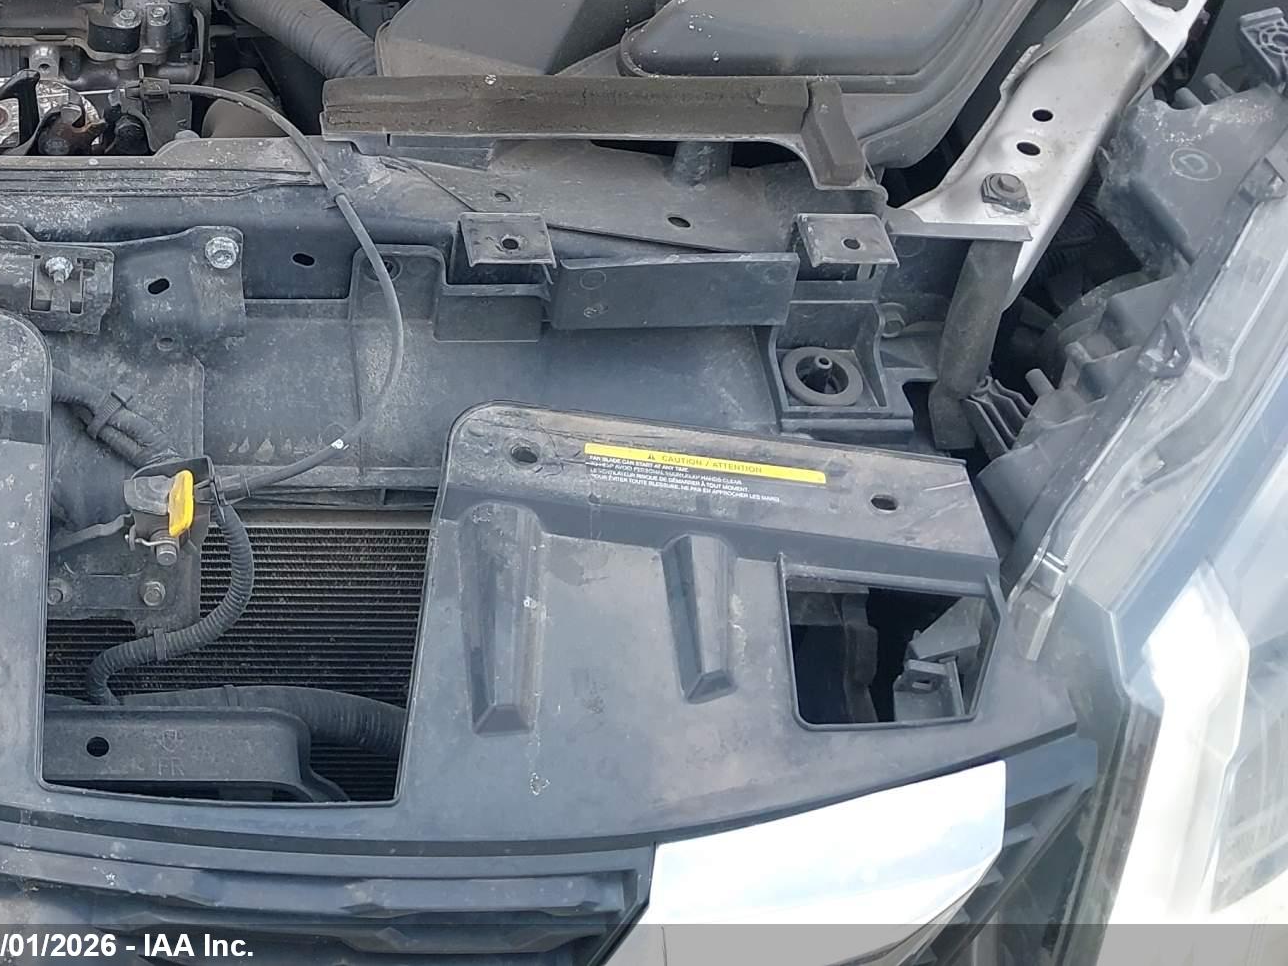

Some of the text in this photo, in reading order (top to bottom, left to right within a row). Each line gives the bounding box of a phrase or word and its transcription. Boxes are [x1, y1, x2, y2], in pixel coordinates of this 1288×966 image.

[662, 455, 701, 466] CAUTION
[712, 461, 761, 473] ATTENTION
[157, 756, 185, 776] FR
